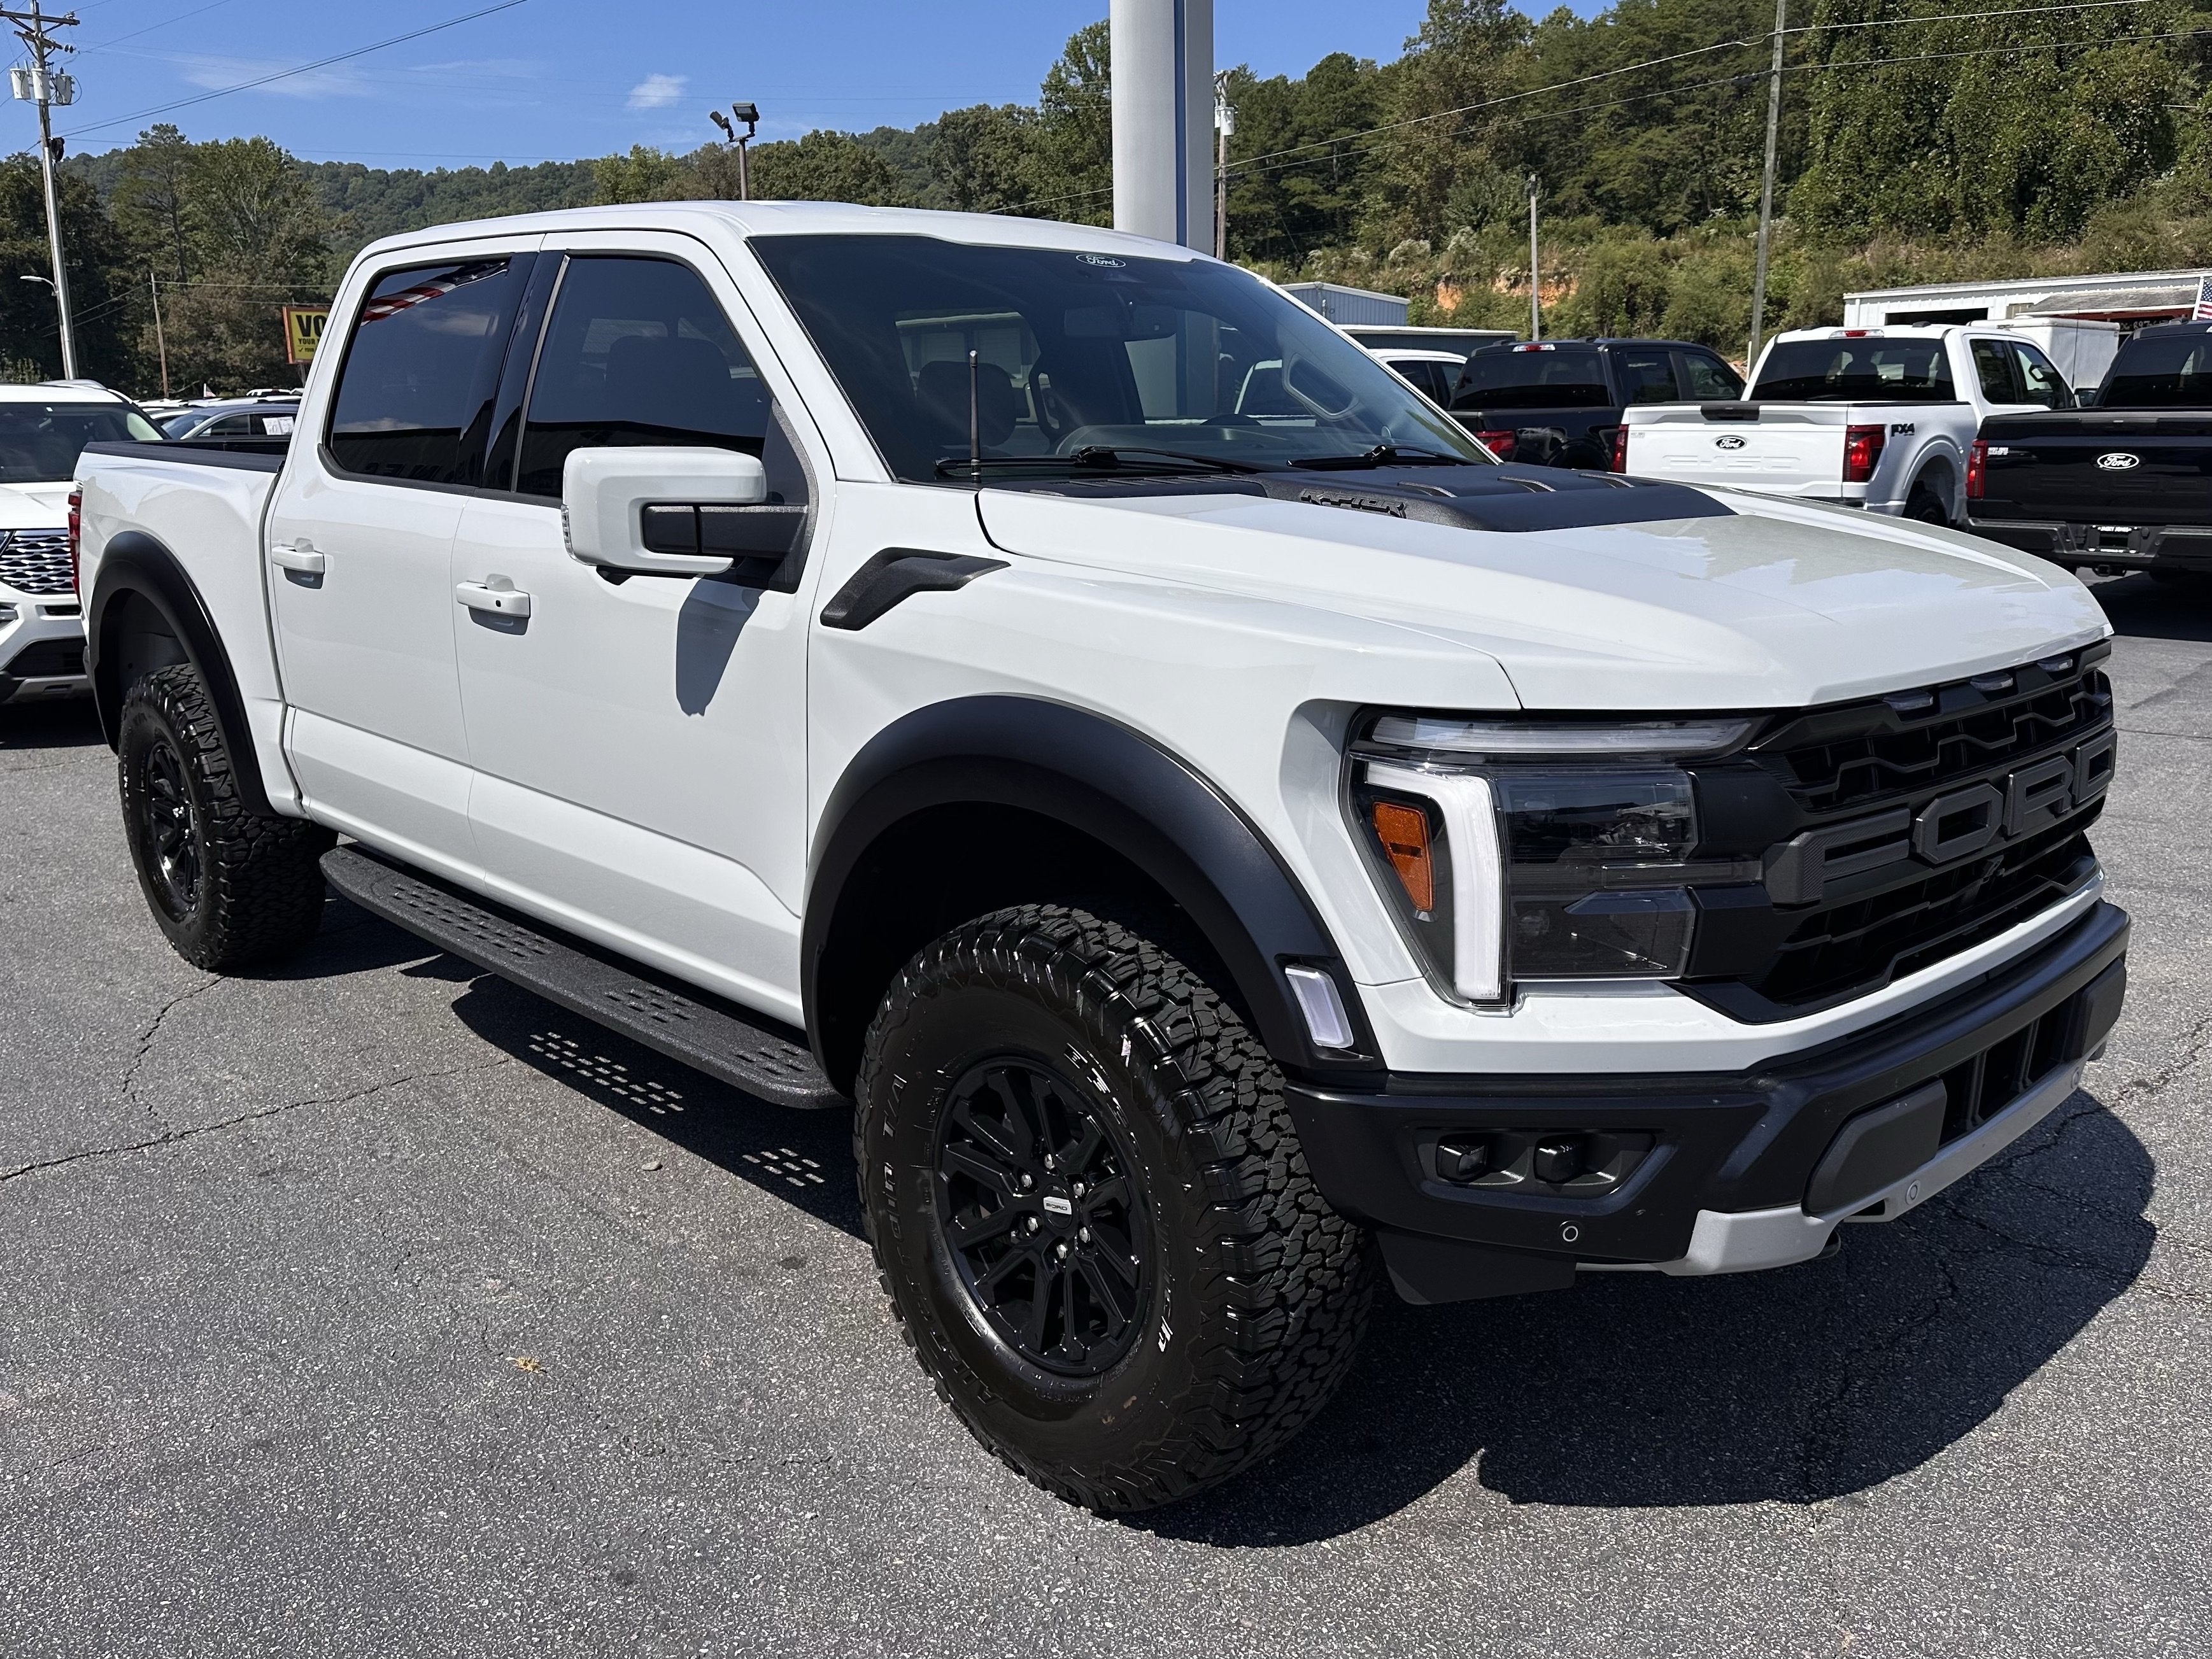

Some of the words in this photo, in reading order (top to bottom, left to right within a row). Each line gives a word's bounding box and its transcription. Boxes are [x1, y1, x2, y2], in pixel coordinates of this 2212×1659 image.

[1085, 255, 1119, 267] Ford
[1891, 423, 1915, 437] FX4
[1719, 437, 1743, 449] Ford
[2103, 455, 2133, 467] Ford
[1300, 488, 1407, 519] RAPTOR
[1773, 728, 2117, 904] FORD
[1046, 1203, 1068, 1211] FORD
